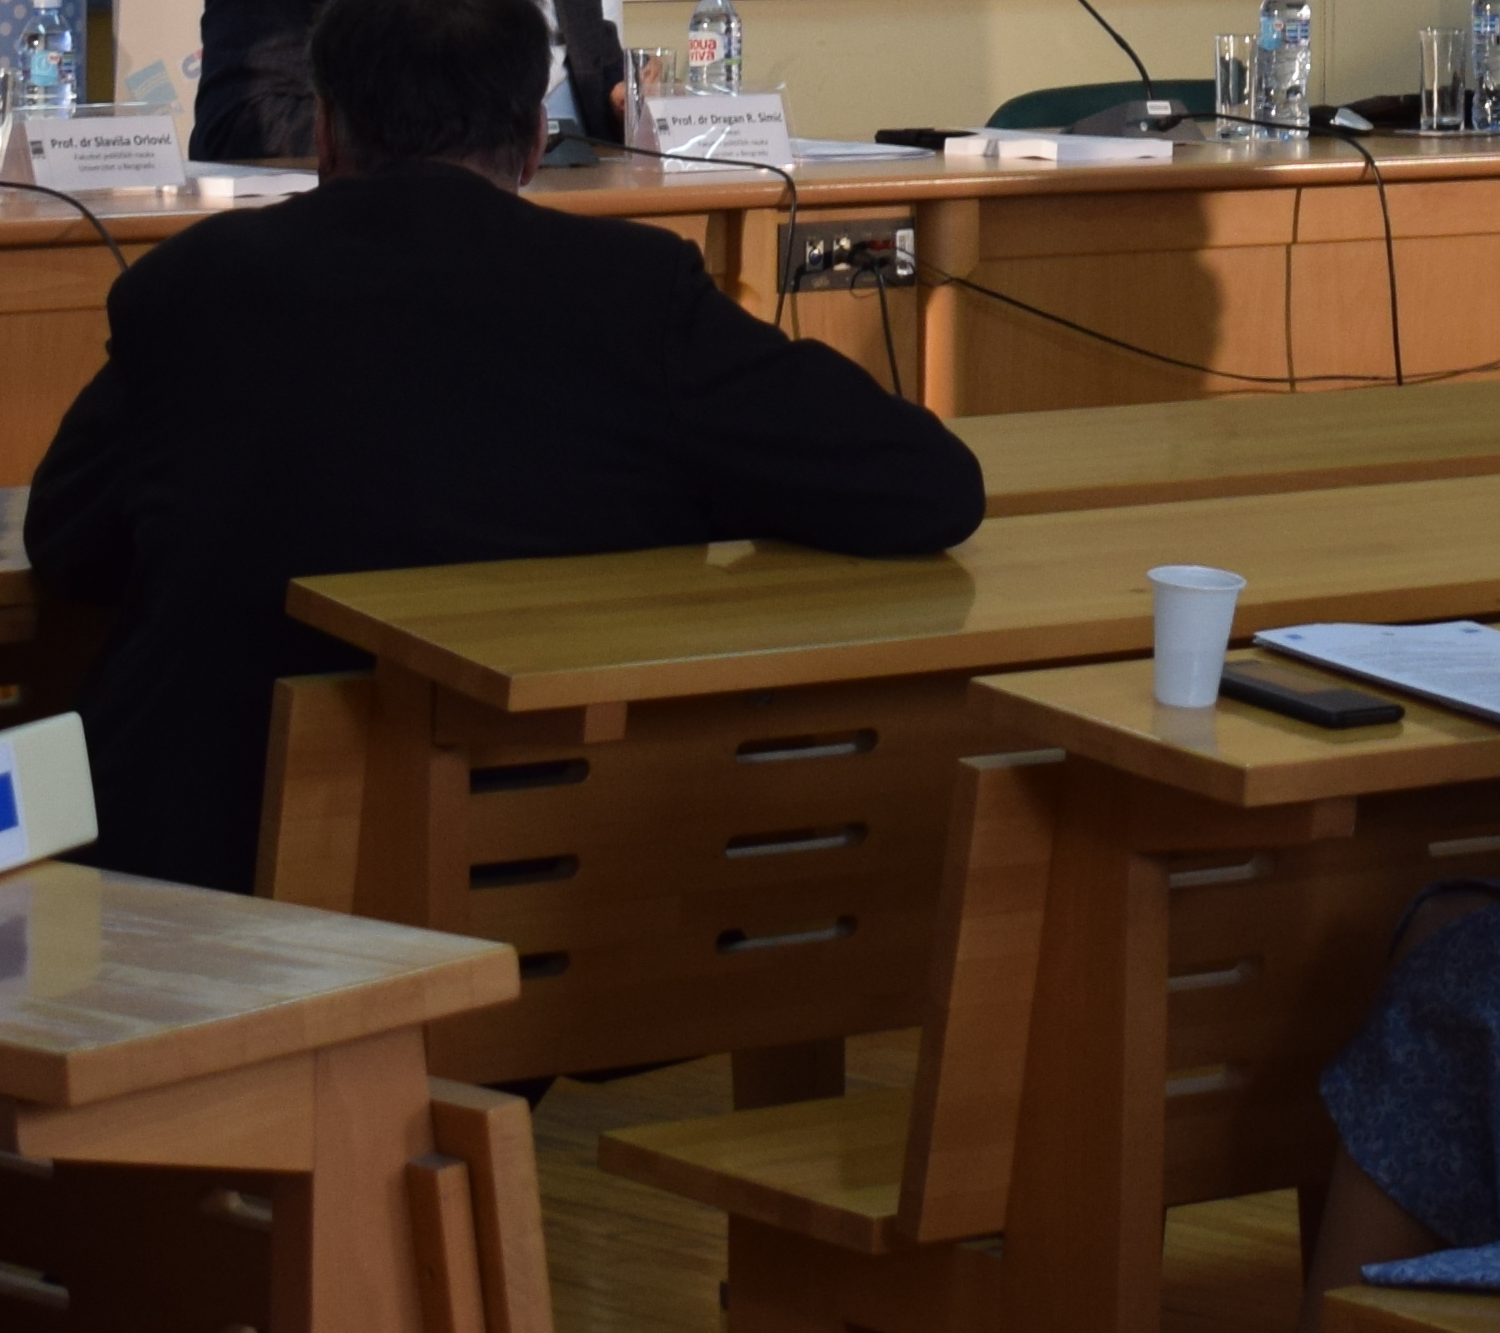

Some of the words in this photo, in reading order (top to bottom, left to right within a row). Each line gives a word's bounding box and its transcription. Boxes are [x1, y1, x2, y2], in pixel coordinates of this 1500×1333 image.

[671, 114, 697, 126] Prof.
[709, 113, 745, 126] Dragan
[50, 137, 77, 149] Prof.
